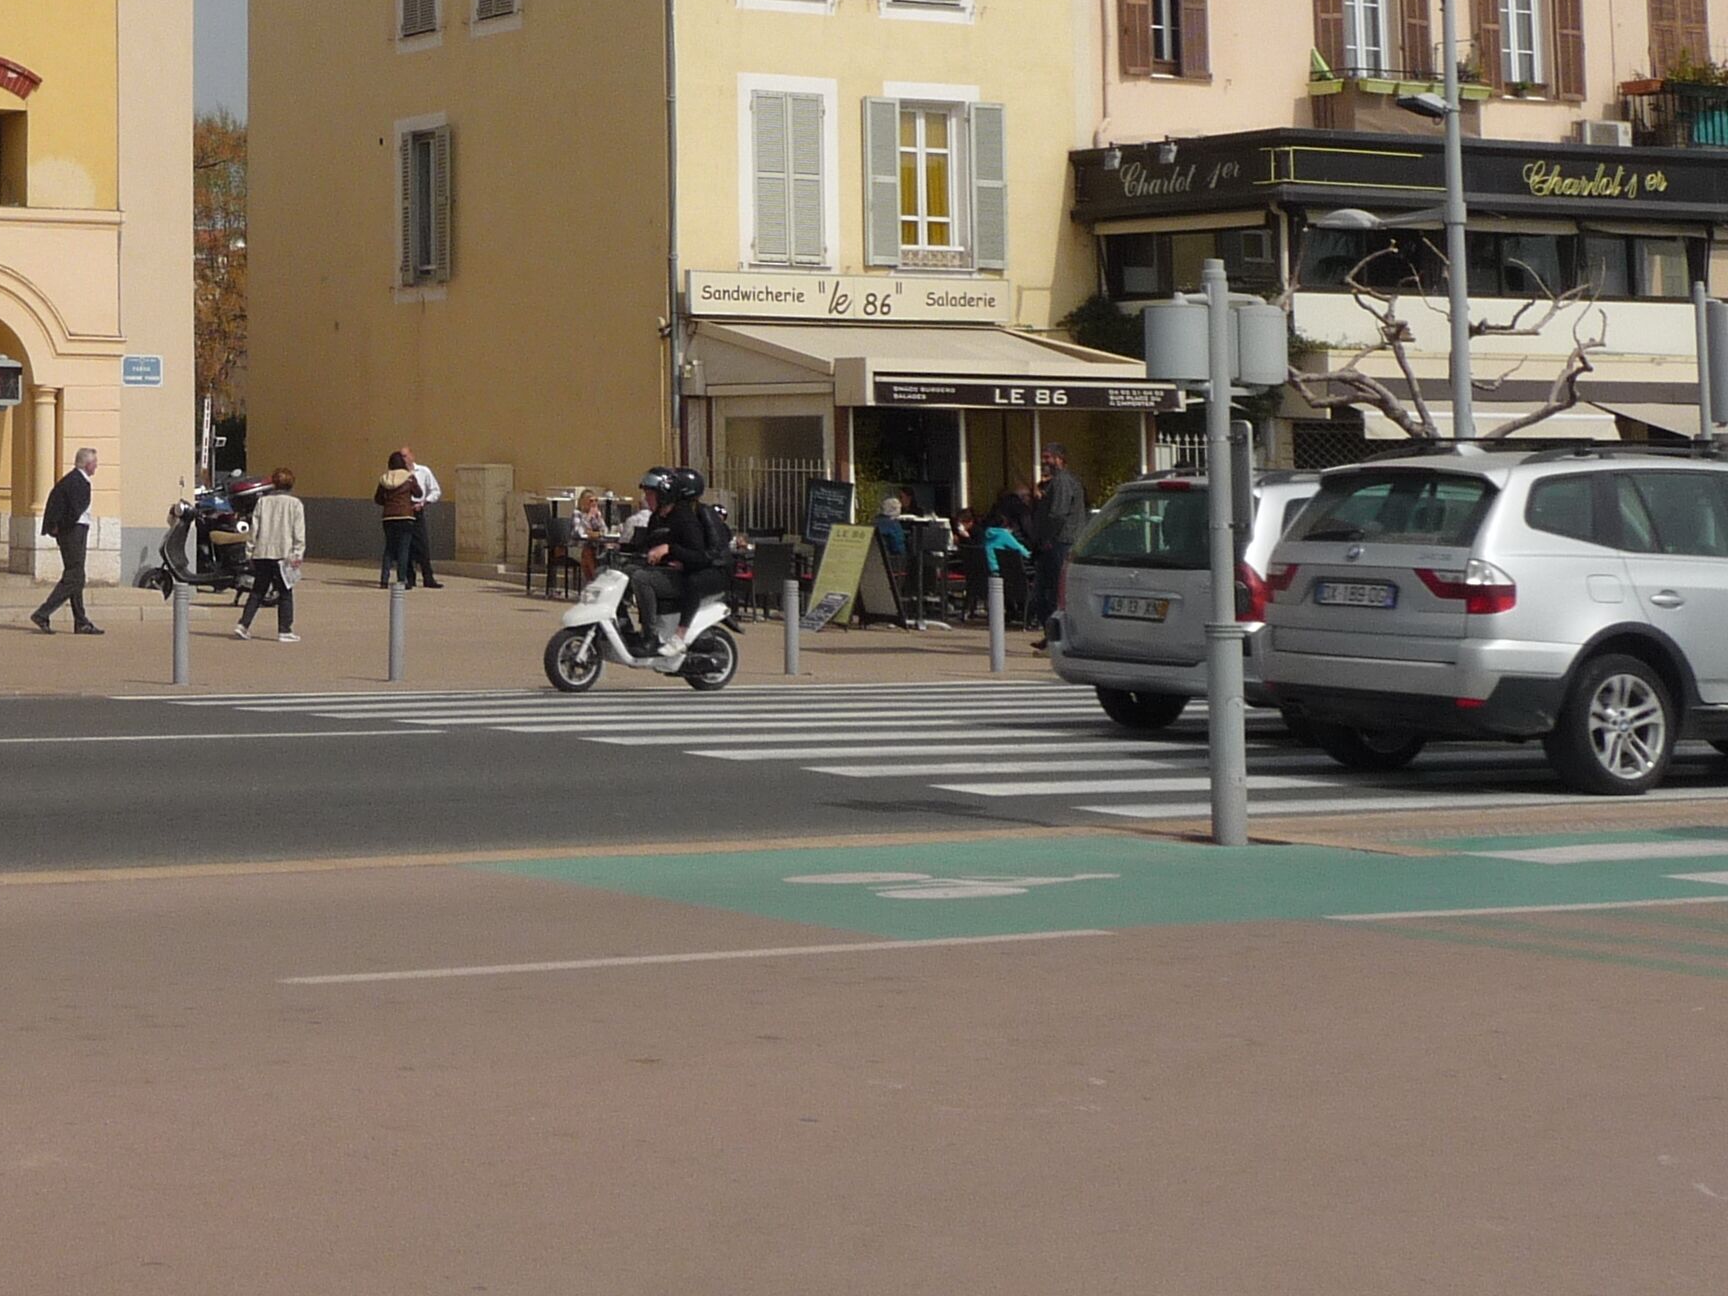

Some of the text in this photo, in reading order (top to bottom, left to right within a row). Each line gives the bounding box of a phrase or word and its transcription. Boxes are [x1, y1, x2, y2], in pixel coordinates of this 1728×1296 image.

[1120, 162, 1196, 197] Charlot
[1523, 160, 1625, 196] Charlot
[701, 284, 805, 303] Sandwicherie
[925, 291, 996, 308] Saladerie
[995, 388, 1068, 405] LE 86
